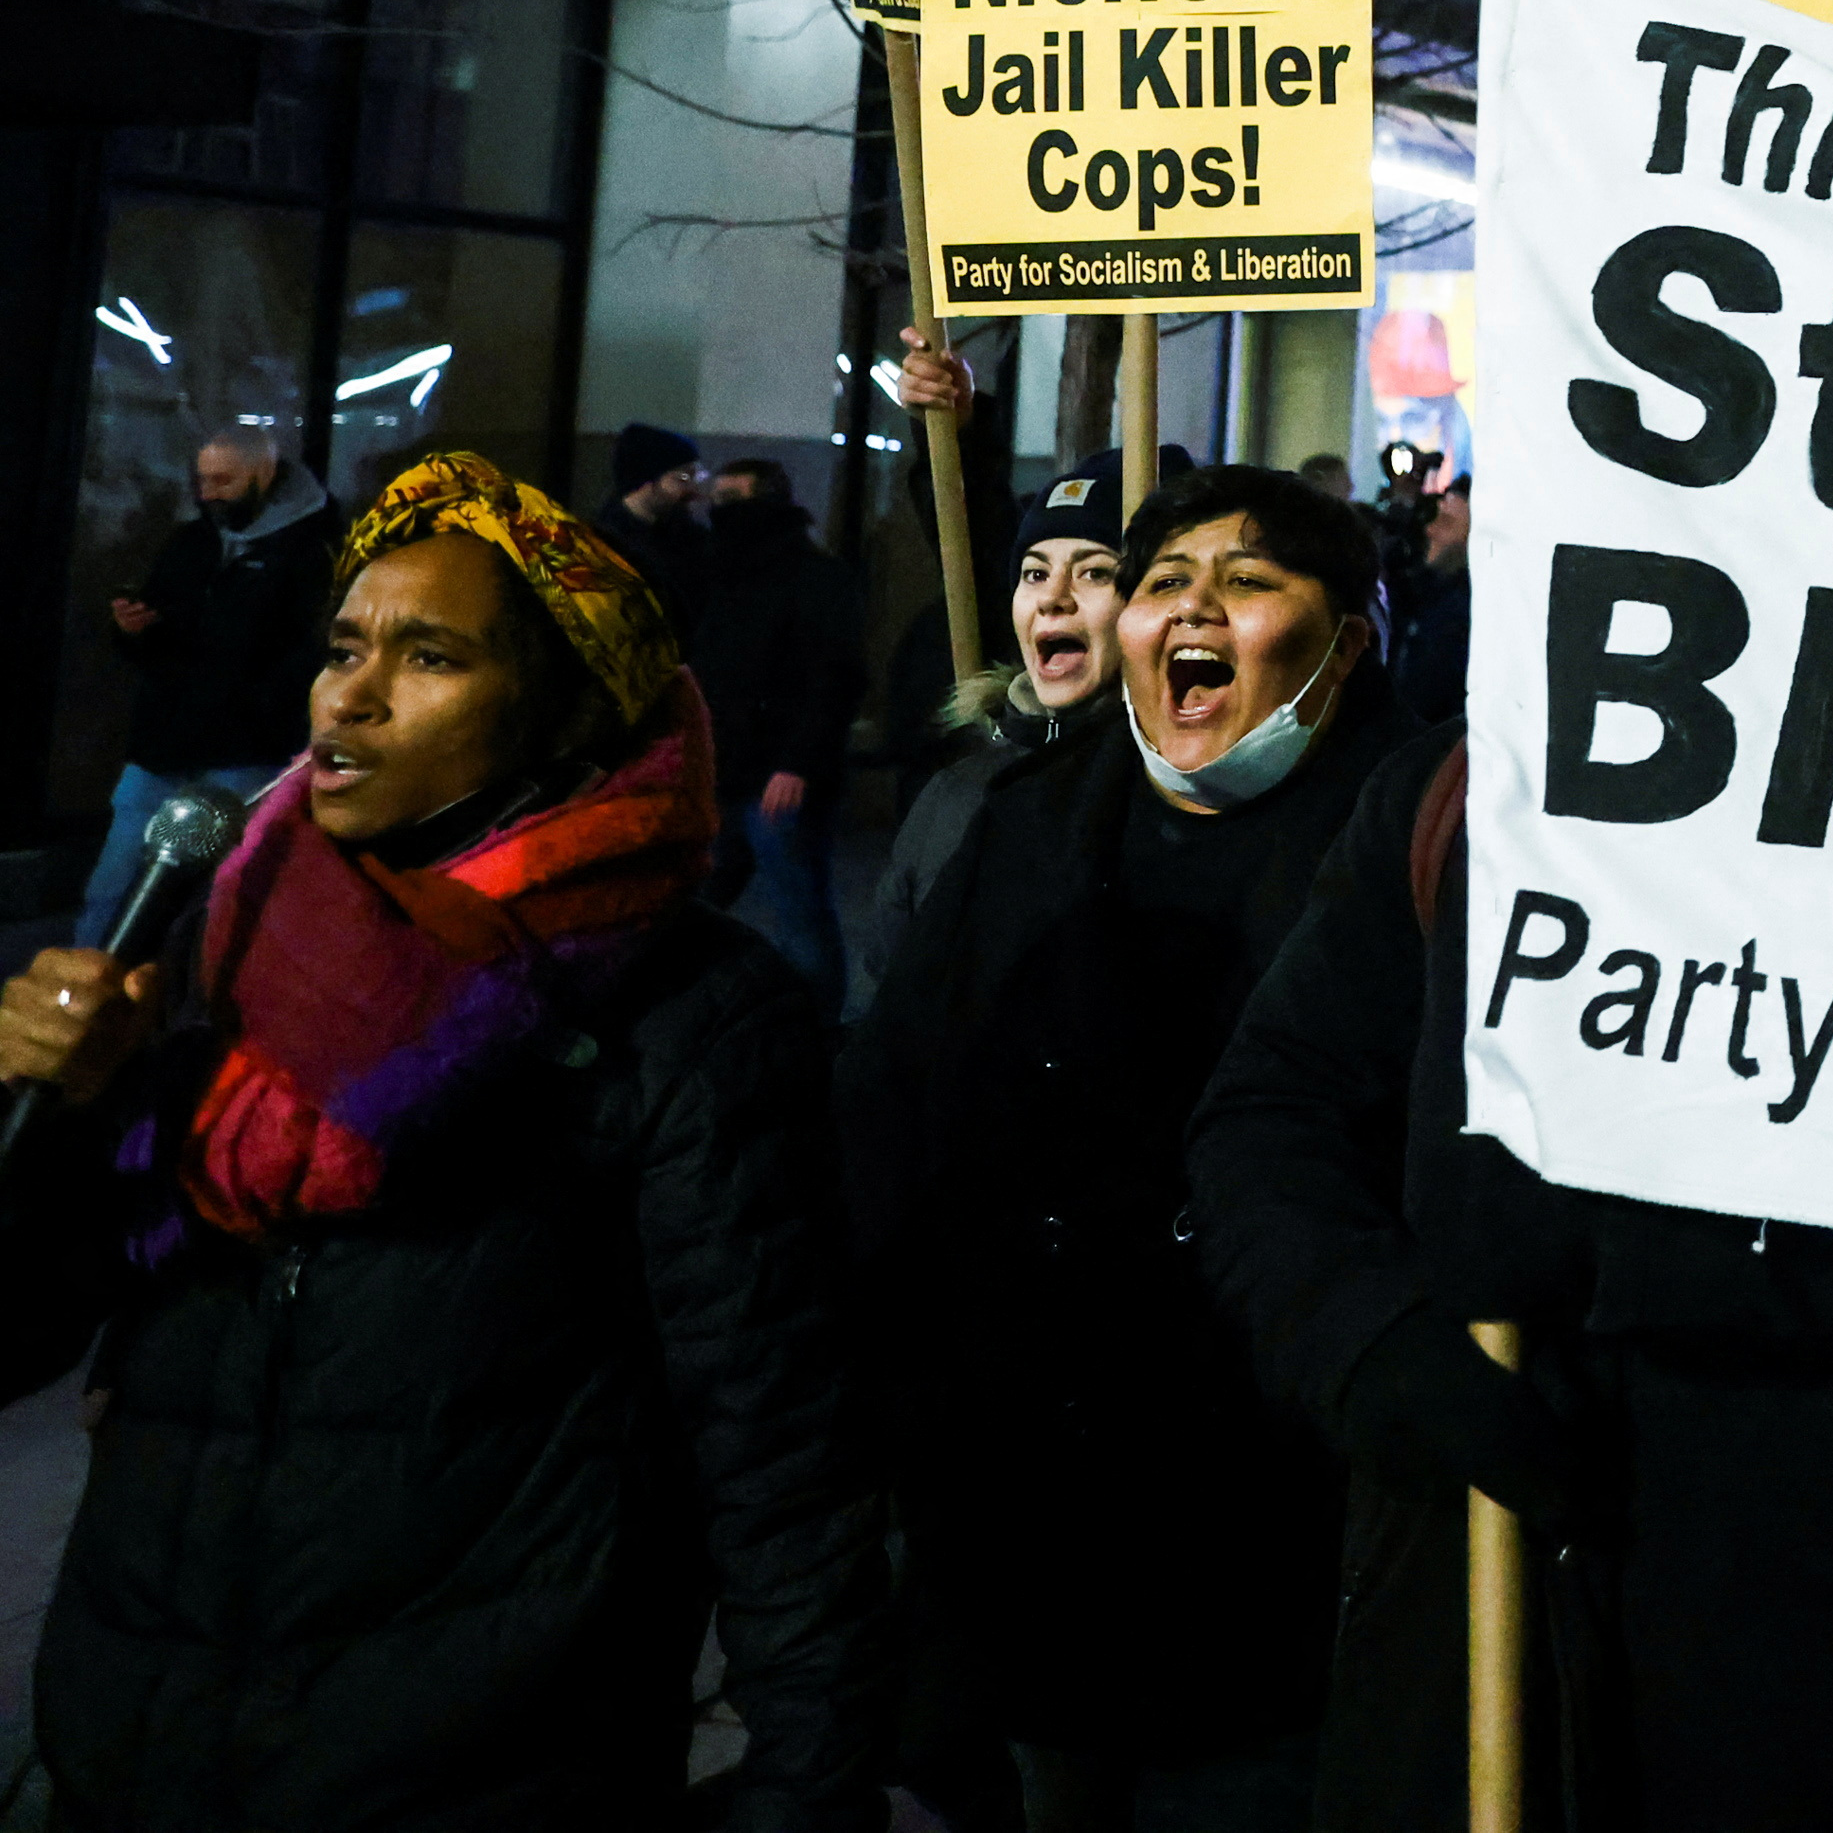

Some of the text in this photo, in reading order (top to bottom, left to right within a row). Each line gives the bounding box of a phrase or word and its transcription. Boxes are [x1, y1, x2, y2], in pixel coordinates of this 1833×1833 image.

[942, 26, 1350, 116] Jail Killer
[1028, 125, 1259, 231] Cops!
[952, 247, 1351, 294] Party for Socialism & Liberation
